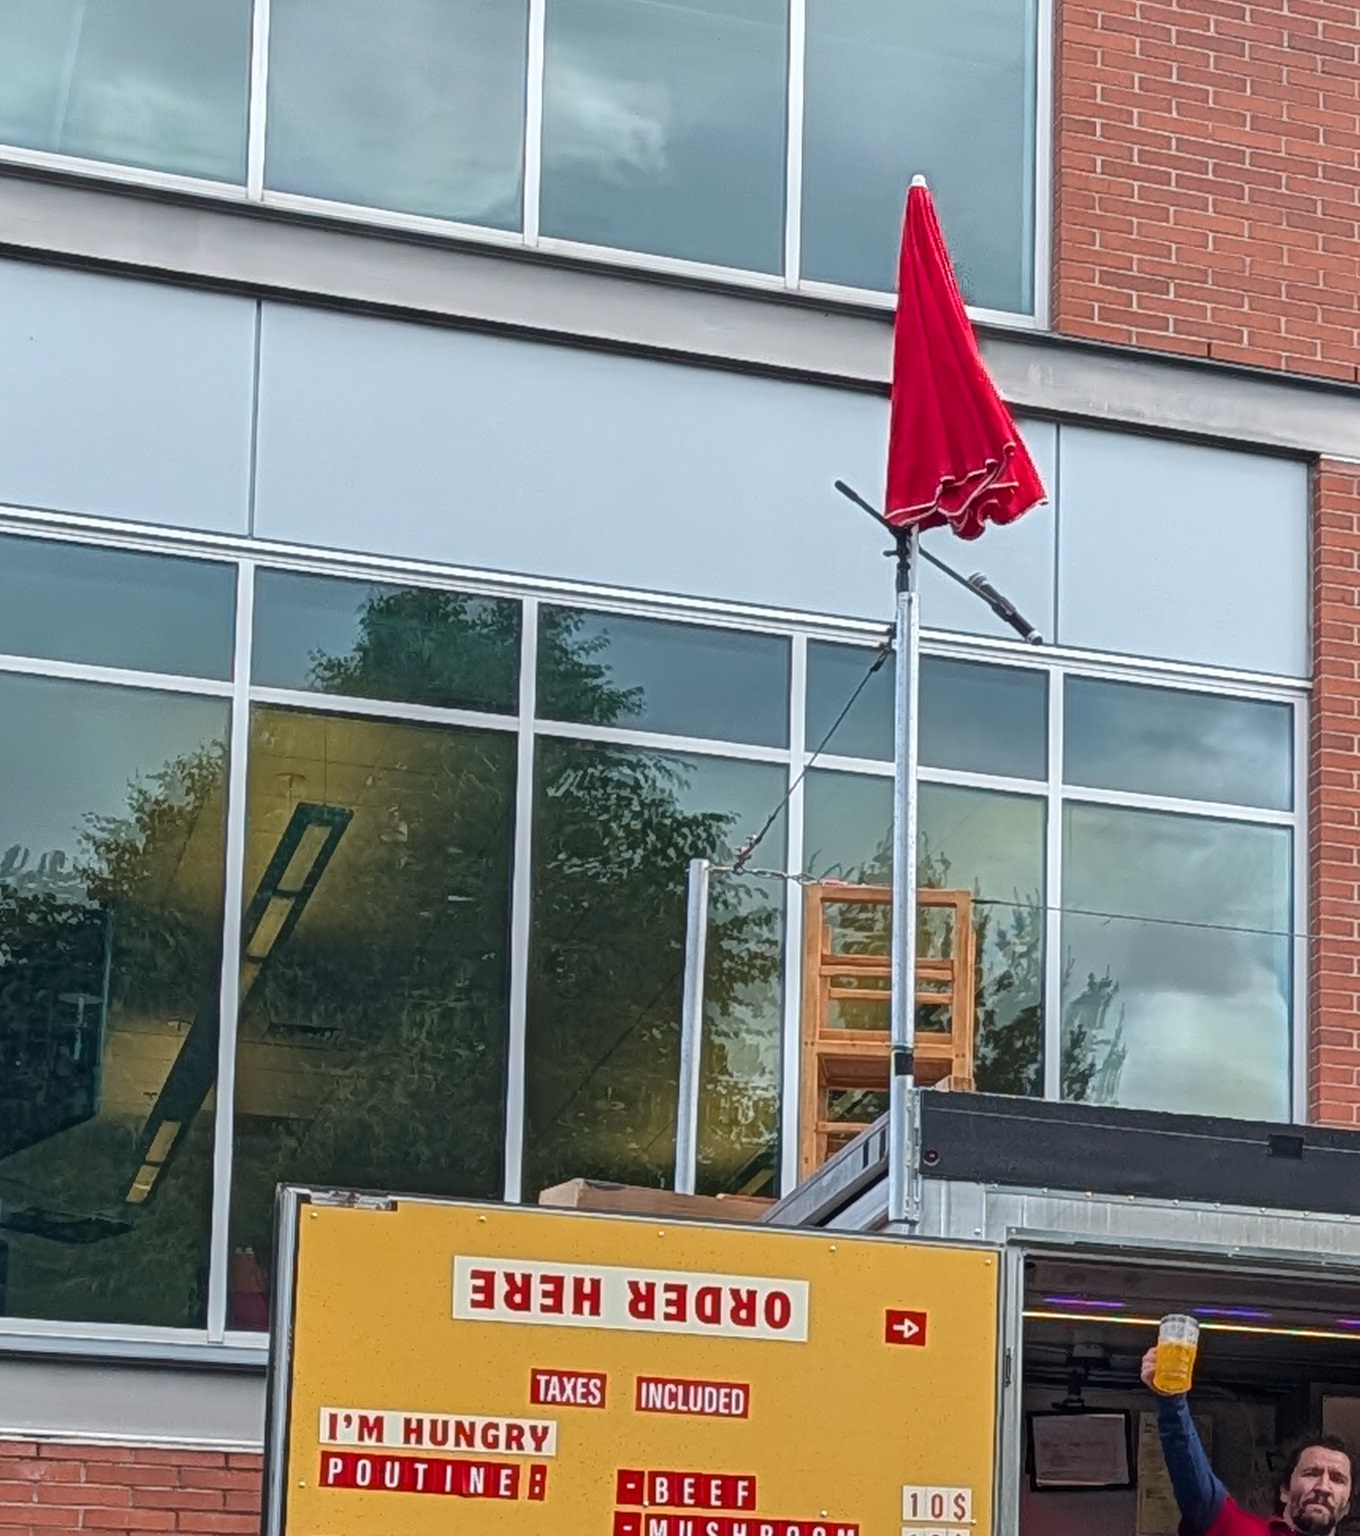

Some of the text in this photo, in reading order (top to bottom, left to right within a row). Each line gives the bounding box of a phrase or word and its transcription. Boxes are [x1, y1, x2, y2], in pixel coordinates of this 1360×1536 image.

[469, 1268, 792, 1331] ORDER HERE
[535, 1374, 746, 1417] TAXES INCLUDED
[327, 1411, 551, 1454] I'M HUNGRY
[909, 1490, 968, 1522] 10$
